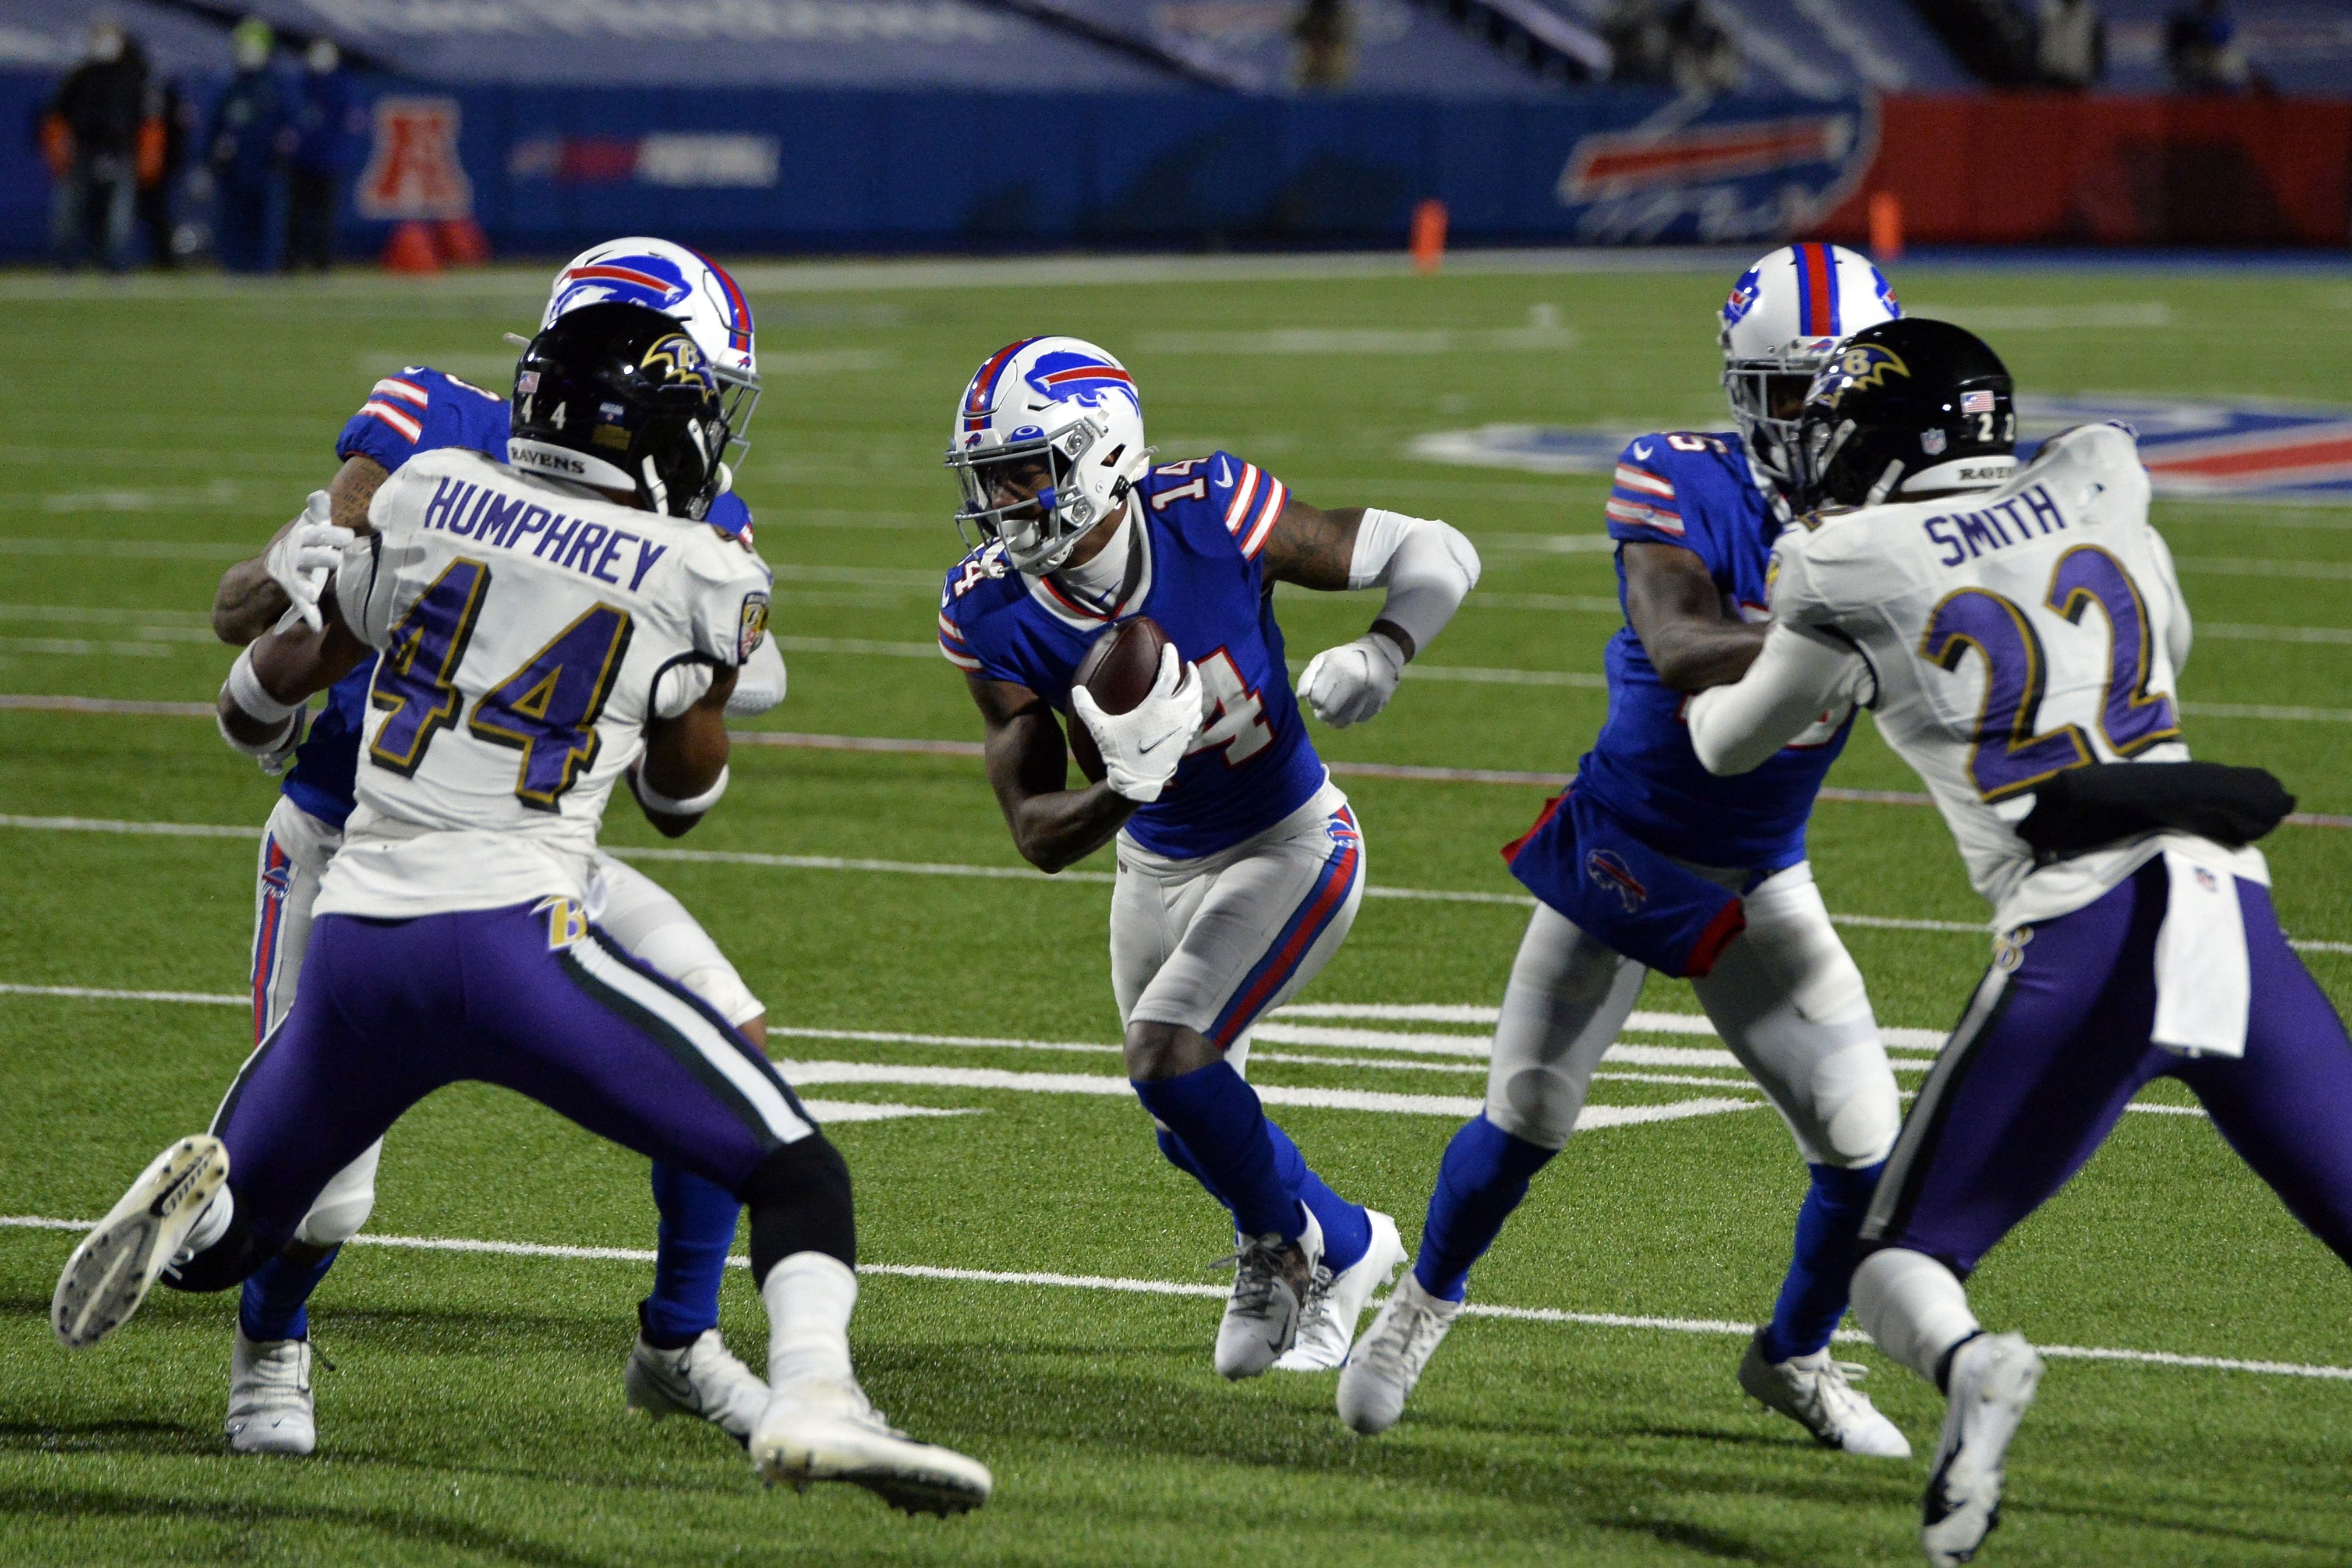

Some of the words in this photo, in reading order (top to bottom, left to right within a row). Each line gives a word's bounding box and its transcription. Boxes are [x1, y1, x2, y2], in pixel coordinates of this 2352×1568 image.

[511, 446, 585, 474] RAVENS
[1150, 457, 1210, 511] 14
[423, 476, 667, 593] HUMPHREY
[1922, 484, 2067, 567] SMITH
[369, 555, 635, 815] 44
[1175, 643, 1278, 774] 4
[1918, 543, 2181, 805] 22
